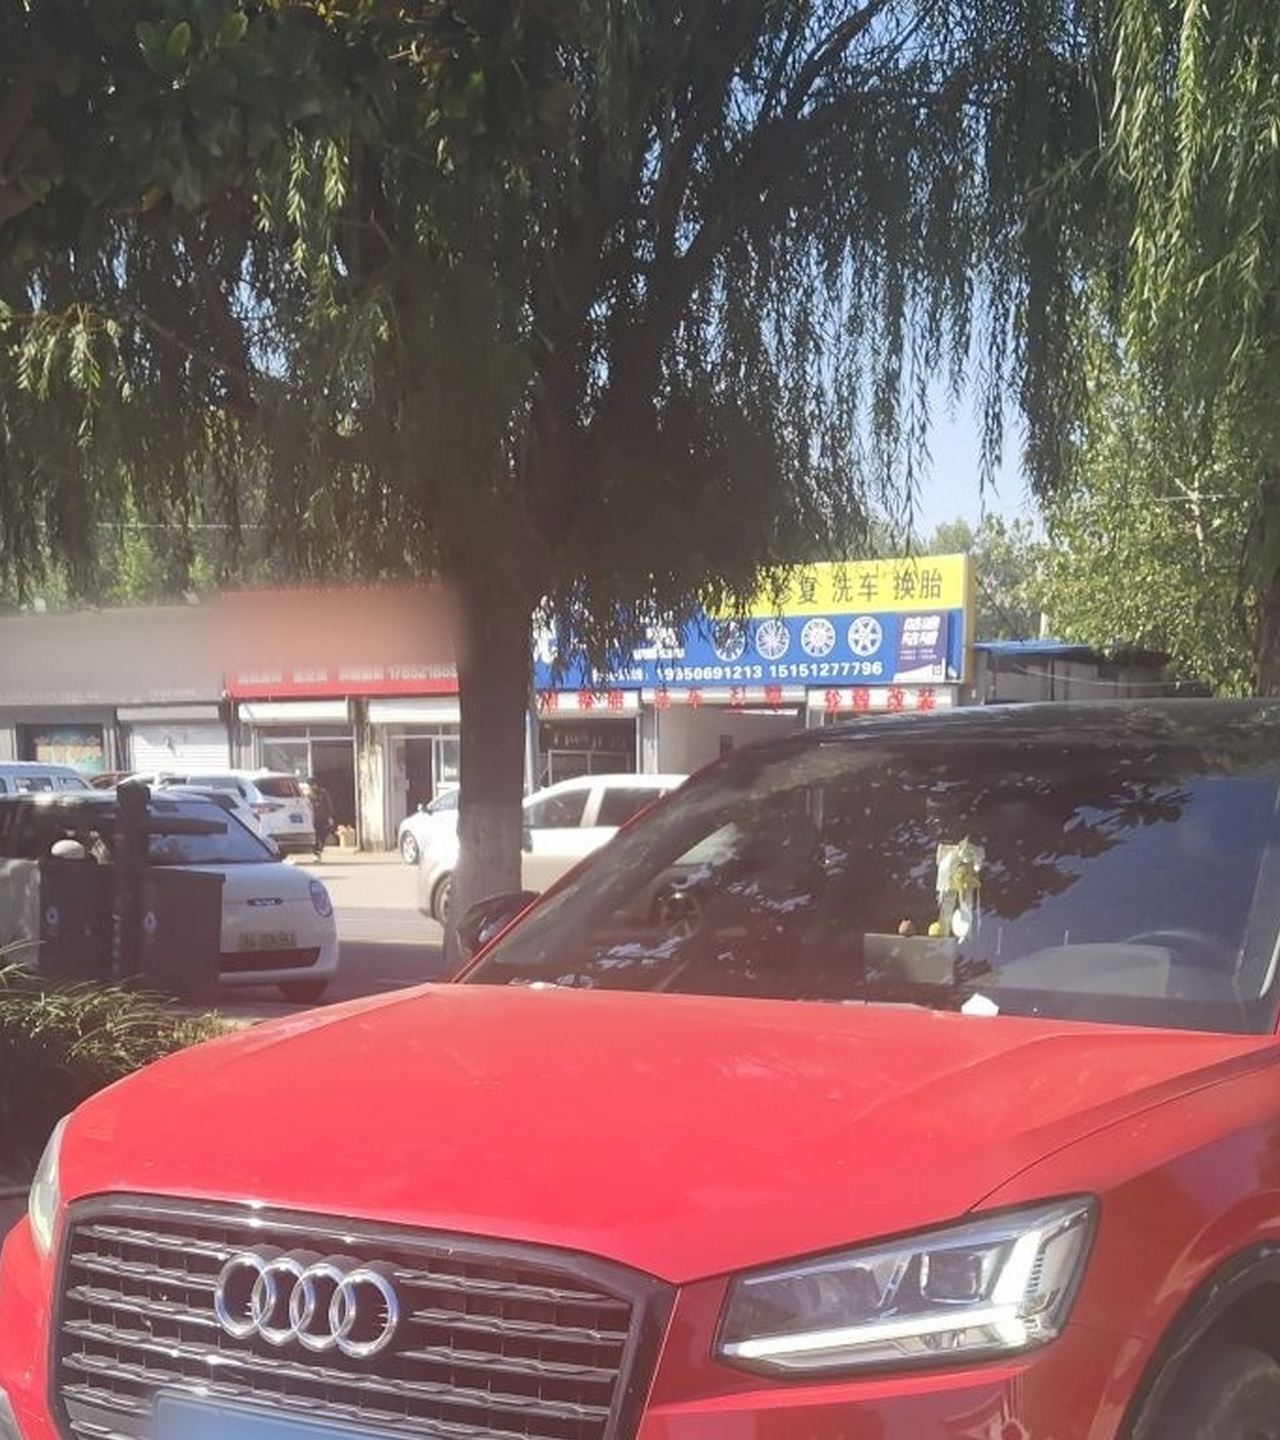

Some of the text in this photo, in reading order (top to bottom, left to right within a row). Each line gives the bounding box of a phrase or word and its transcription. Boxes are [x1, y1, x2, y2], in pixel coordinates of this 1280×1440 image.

[833, 570, 878, 603] 洗车
[894, 568, 943, 600] 换胎
[770, 660, 884, 679] 15151277796
